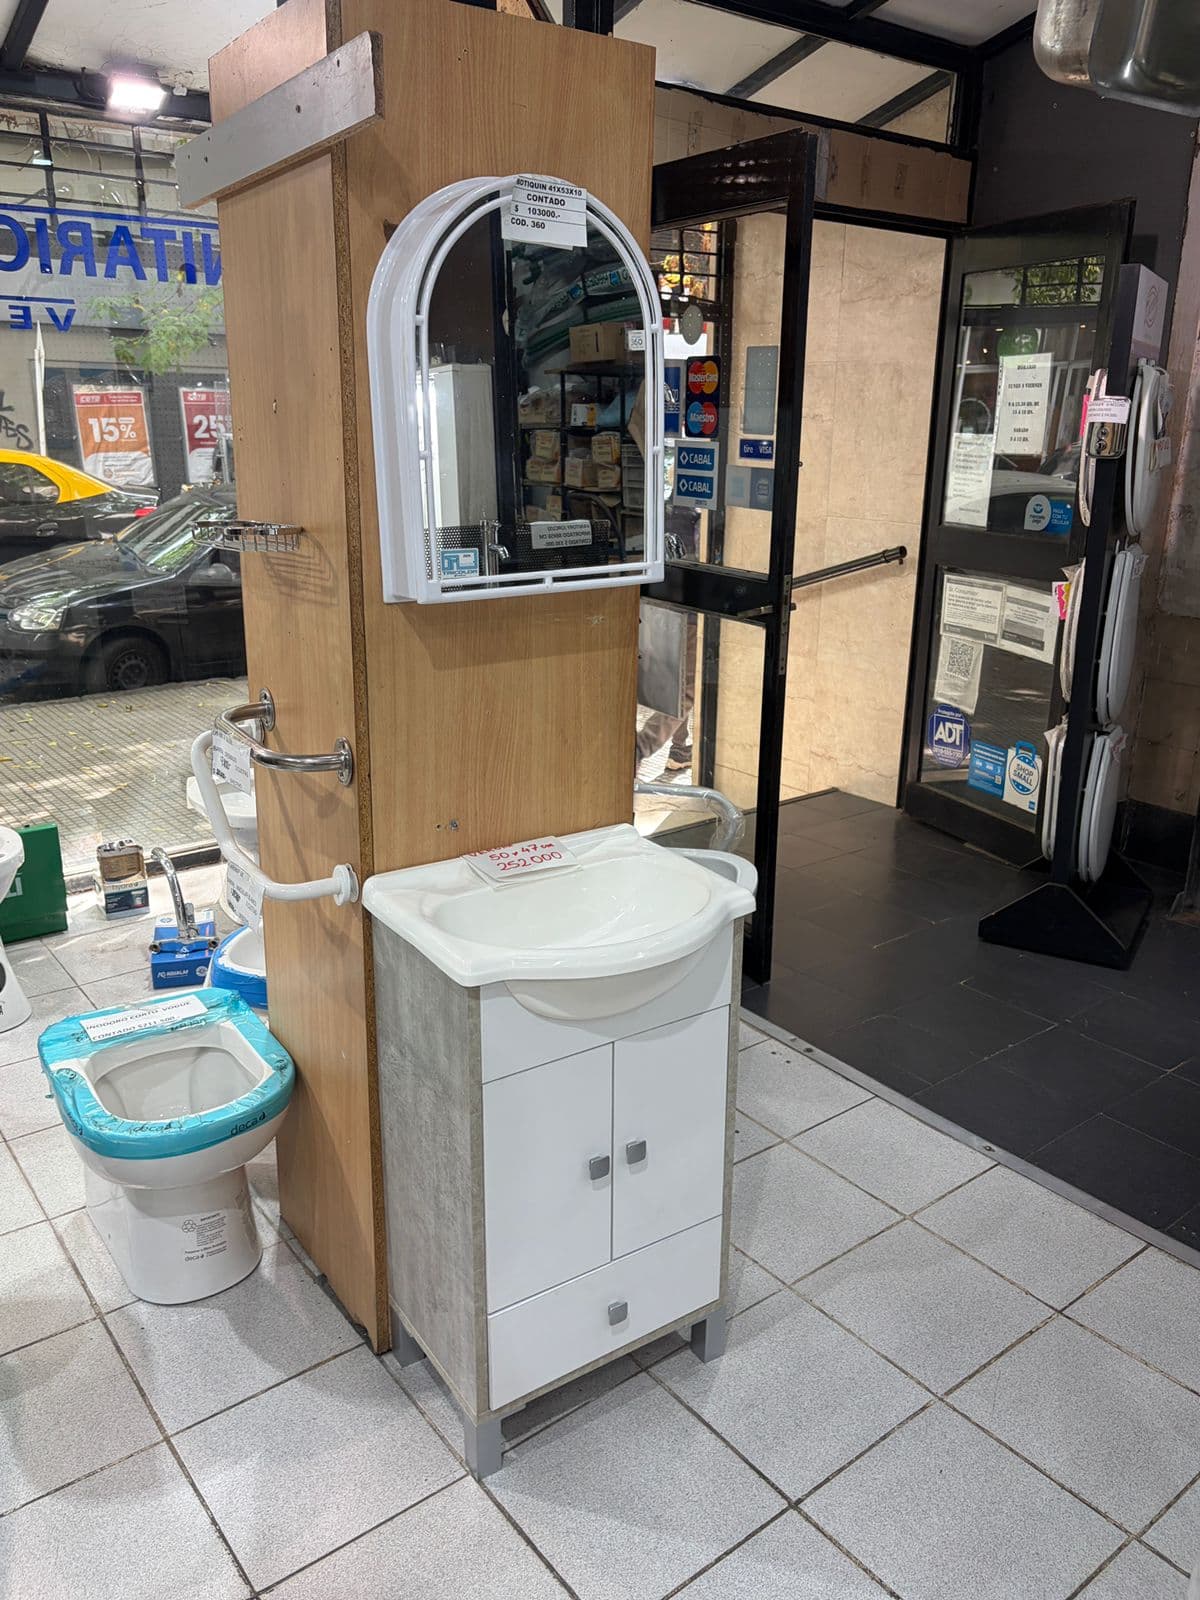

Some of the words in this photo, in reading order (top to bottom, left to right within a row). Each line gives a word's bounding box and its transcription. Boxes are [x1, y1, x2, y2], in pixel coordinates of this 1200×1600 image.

[548, 185, 583, 197] 41X53X10
[526, 193, 566, 206] CONTADO
[510, 217, 529, 227] COD.
[531, 221, 546, 229] 360
[690, 413, 715, 422] Maestro
[88, 417, 137, 443] 15%
[689, 453, 713, 465] CABAL
[688, 480, 711, 493] CABAL
[934, 721, 964, 746] ADT
[1016, 763, 1034, 777] SHOP
[1012, 769, 1033, 787] SMALL
[521, 844, 538, 853] 47
[86, 1016, 128, 1030] INODORO
[92, 1025, 136, 1040] CONTADO
